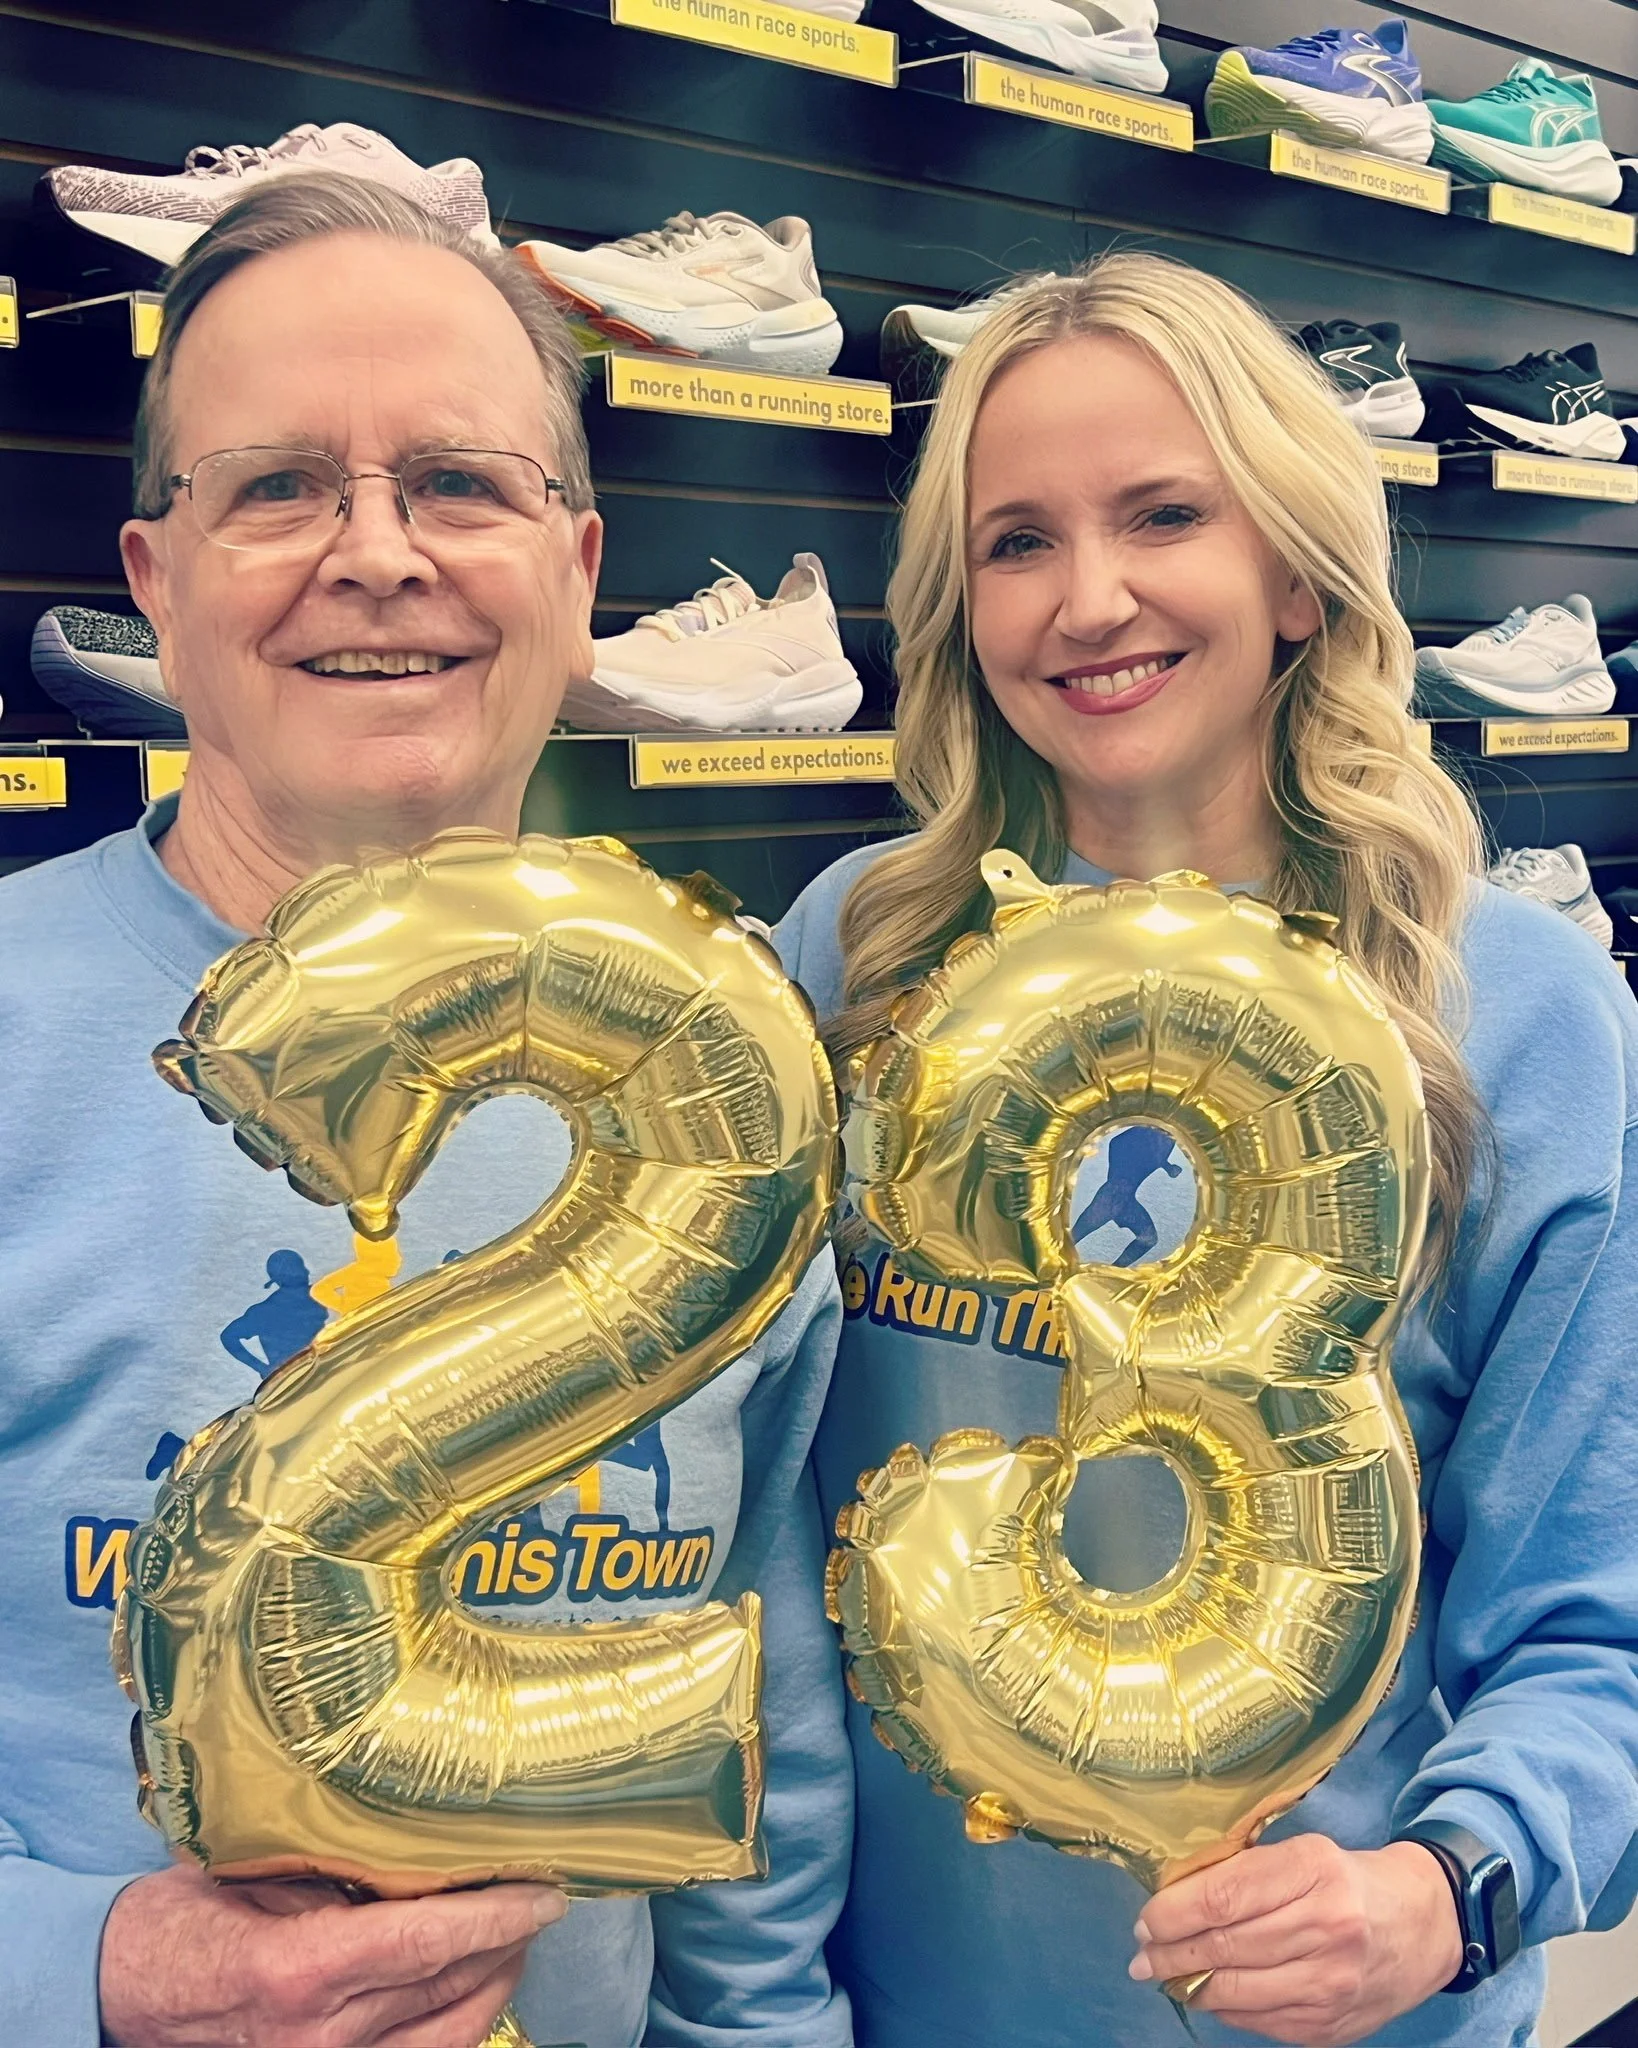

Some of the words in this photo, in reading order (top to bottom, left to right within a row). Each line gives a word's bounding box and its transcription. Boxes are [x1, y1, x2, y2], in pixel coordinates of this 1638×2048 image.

[756, 14, 796, 37] race
[801, 26, 859, 53] sports.
[1001, 76, 1025, 102] the
[1030, 83, 1084, 118] human
[1089, 106, 1120, 128] race
[1125, 117, 1173, 142] sports.
[1292, 149, 1311, 171] the
[1315, 154, 1358, 182] human
[1361, 173, 1387, 190] race
[630, 378, 683, 399] more
[690, 378, 734, 405] than
[741, 393, 752, 408] a
[759, 392, 831, 424] running
[837, 401, 889, 424] store.
[1402, 460, 1436, 478] store.
[1499, 735, 1514, 746] we
[1518, 728, 1552, 745] exceed
[1555, 727, 1618, 748] expectations.
[662, 758, 692, 774] we
[698, 747, 764, 772] exceed
[771, 745, 889, 775] expectations.
[875, 1256, 981, 1335] Run
[999, 1289, 1066, 1358] Th
[571, 1524, 711, 1591] Town
